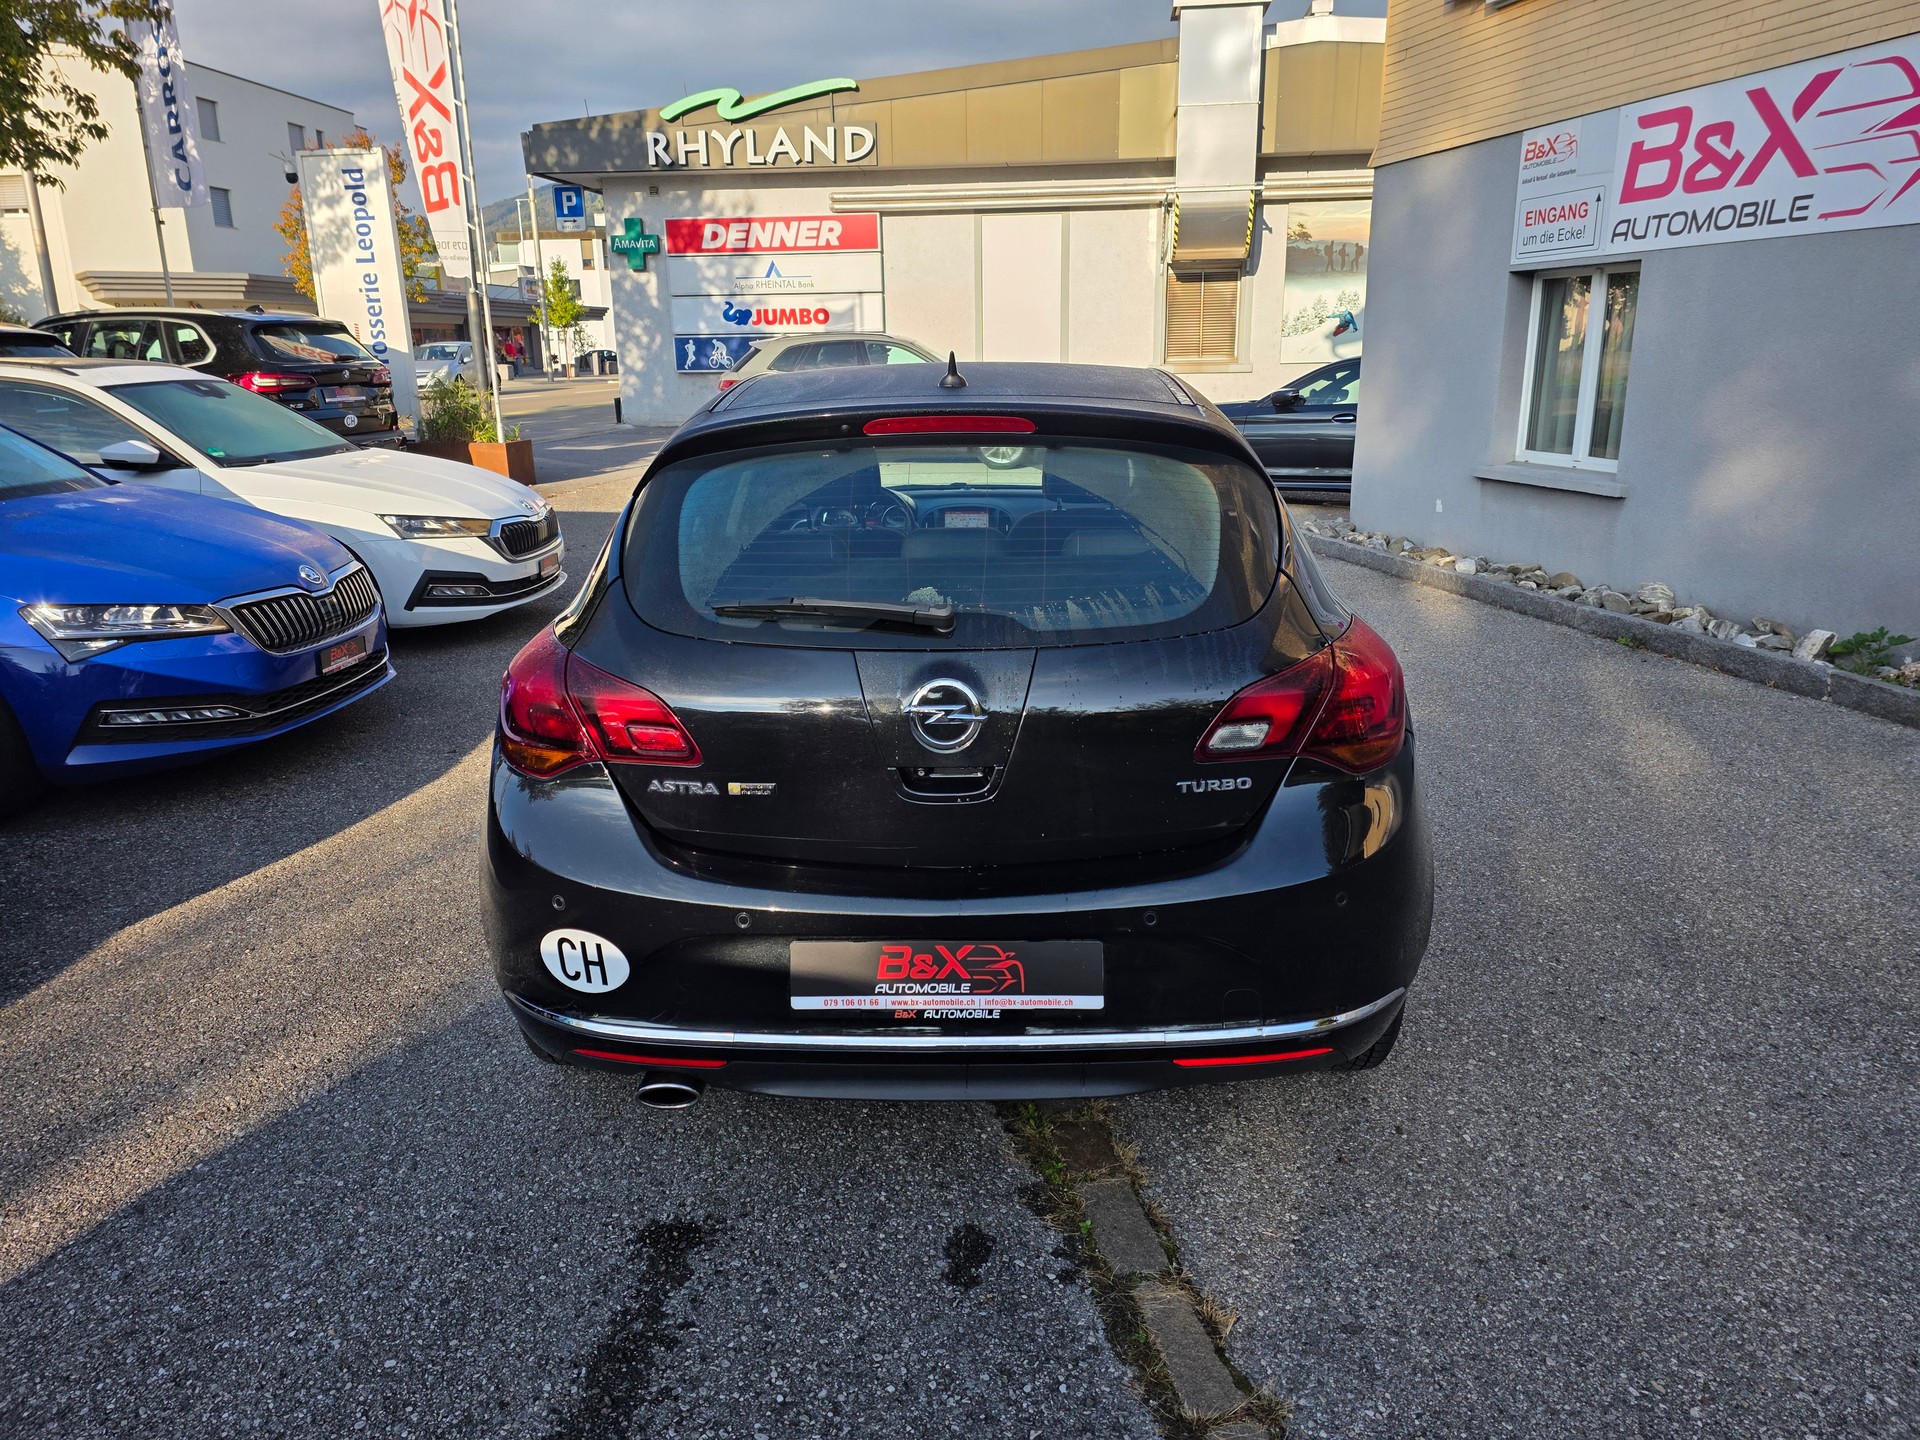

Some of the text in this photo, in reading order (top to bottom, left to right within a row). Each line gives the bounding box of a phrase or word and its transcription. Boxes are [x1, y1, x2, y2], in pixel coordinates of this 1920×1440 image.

[646, 125, 875, 167] RHYLAND
[1619, 67, 1845, 205] B&X
[1524, 134, 1561, 163] B&X
[1522, 157, 1558, 171] AUTOMOBILE
[562, 191, 577, 215] P
[1525, 201, 1589, 227] EINGANG
[341, 168, 377, 264] Leopold
[1610, 194, 1815, 244] AUTOMOBILE
[702, 220, 842, 250] DENNER
[1522, 225, 1587, 247] um die Ecke!
[733, 280, 815, 292] Alpha RHEINTAL Bank
[752, 307, 830, 326] JUMBO
[346, 416, 356, 426] CH
[647, 779, 720, 796] ASTRA
[1176, 777, 1252, 793] TURBO
[557, 937, 609, 986] CH
[877, 945, 976, 980] B&X
[875, 983, 972, 994] AUTOMOBILE
[823, 998, 1073, 1007] 079 106 01 66 www.bx-automobile.ch info@bx-automobile.ch
[894, 1009, 1001, 1019] B&X AUTOMOBILE
